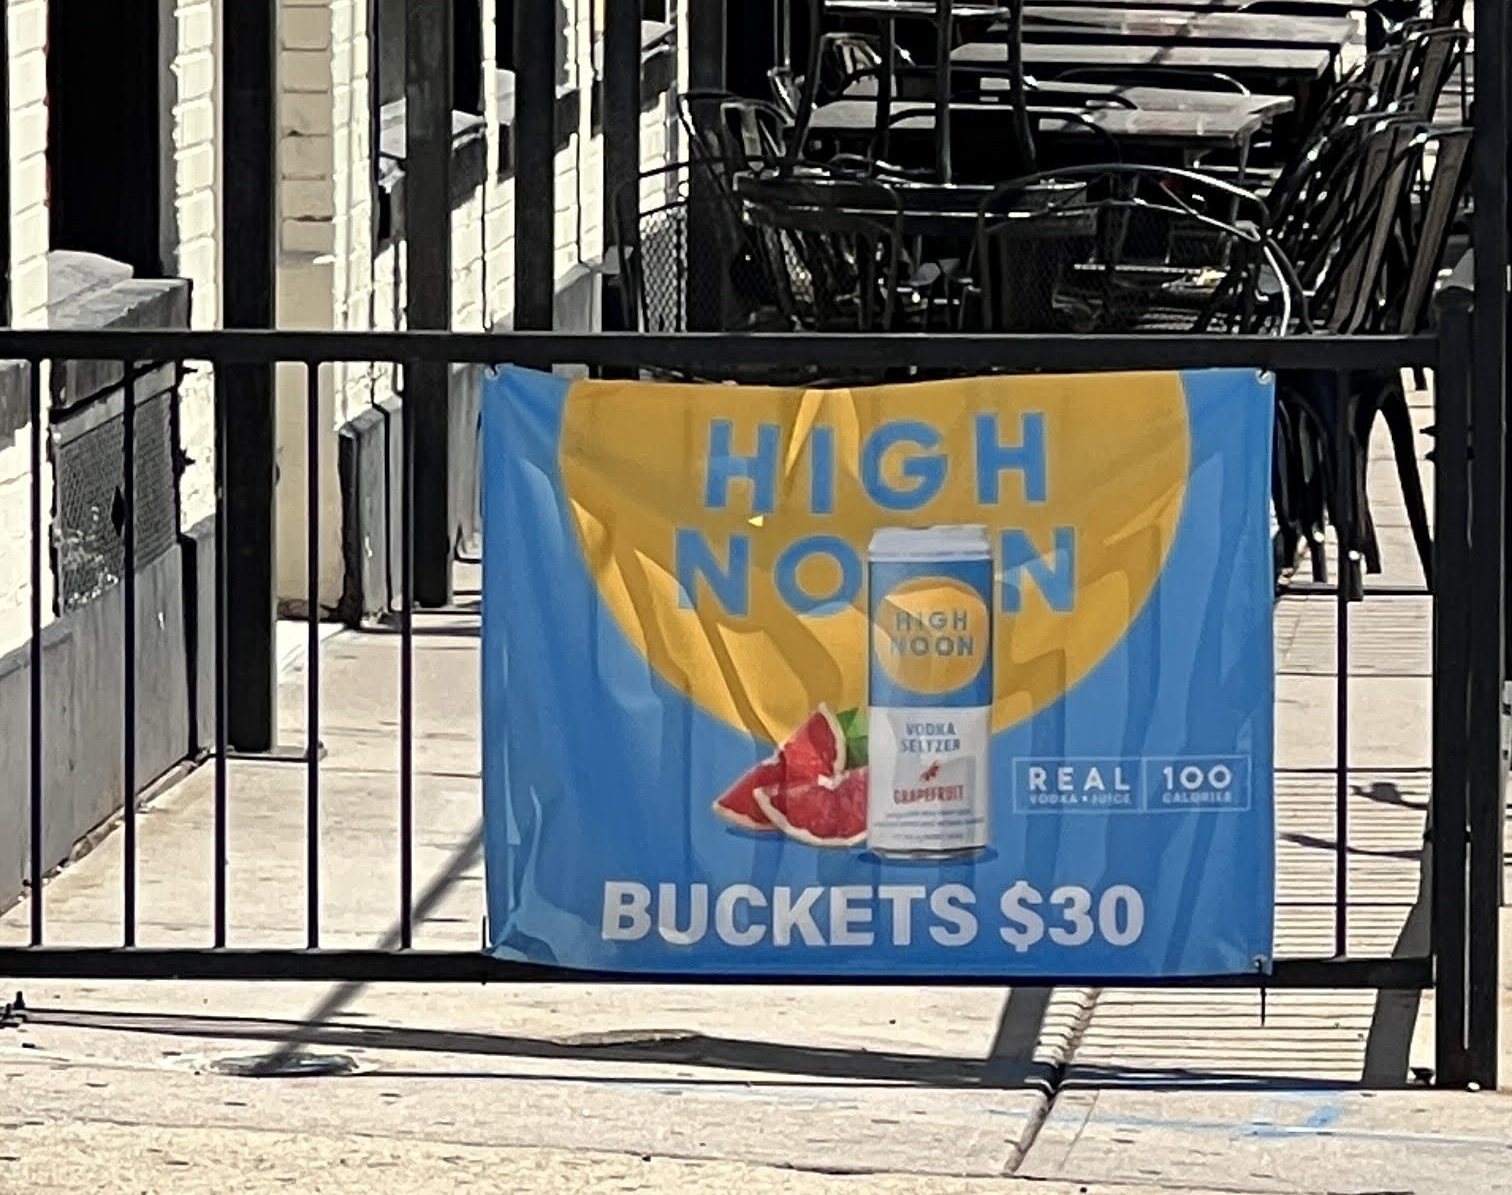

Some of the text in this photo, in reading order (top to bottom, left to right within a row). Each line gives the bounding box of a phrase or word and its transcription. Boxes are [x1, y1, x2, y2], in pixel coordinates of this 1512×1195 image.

[704, 411, 1048, 515] HIGH
[674, 526, 1077, 619] NON
[896, 611, 969, 632] HIGH
[890, 636, 974, 657] NOON
[905, 722, 957, 737] VODKA
[902, 739, 961, 754] SELTZER
[1028, 766, 1131, 792] REAL
[1162, 764, 1233, 791] 100
[893, 785, 965, 805] GRAPEFRUIT
[1029, 793, 1078, 805] VODKA
[602, 881, 1145, 952] BUCKETS $30
